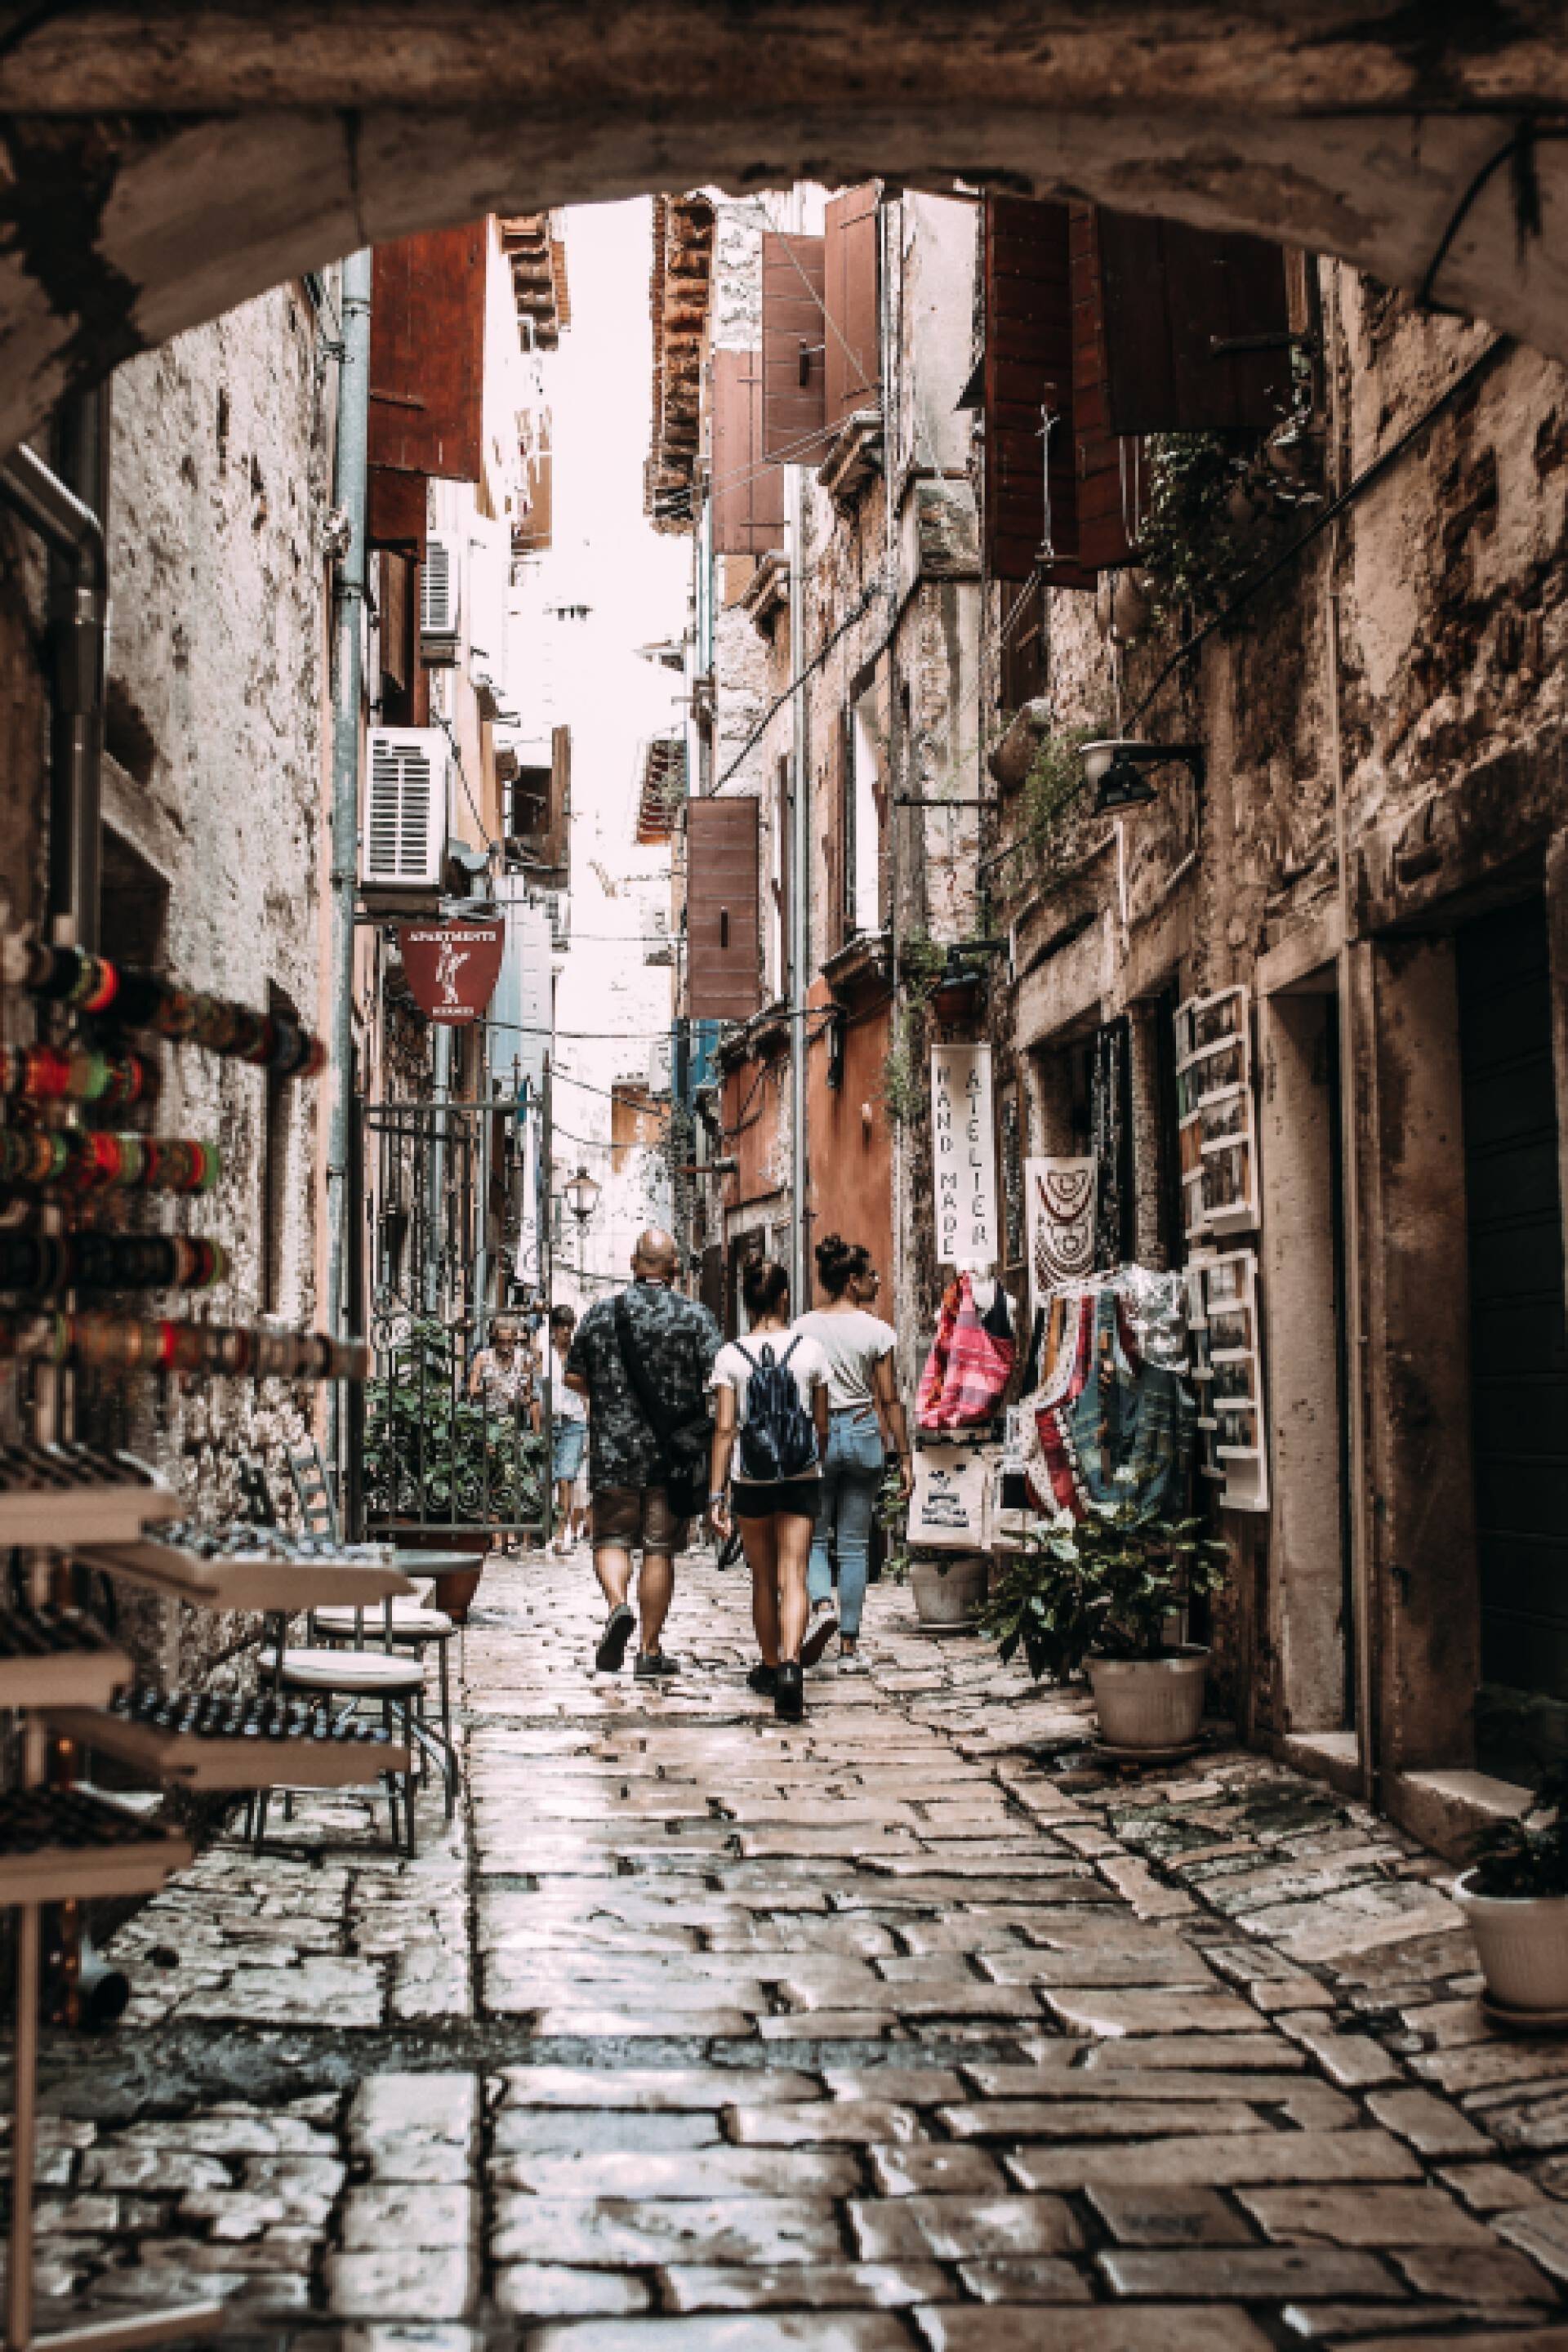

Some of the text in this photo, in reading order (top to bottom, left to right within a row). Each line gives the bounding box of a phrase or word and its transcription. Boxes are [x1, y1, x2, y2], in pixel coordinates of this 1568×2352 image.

[937, 1066, 957, 1255] HAND MADE
[965, 1068, 989, 1246] ATELIER
